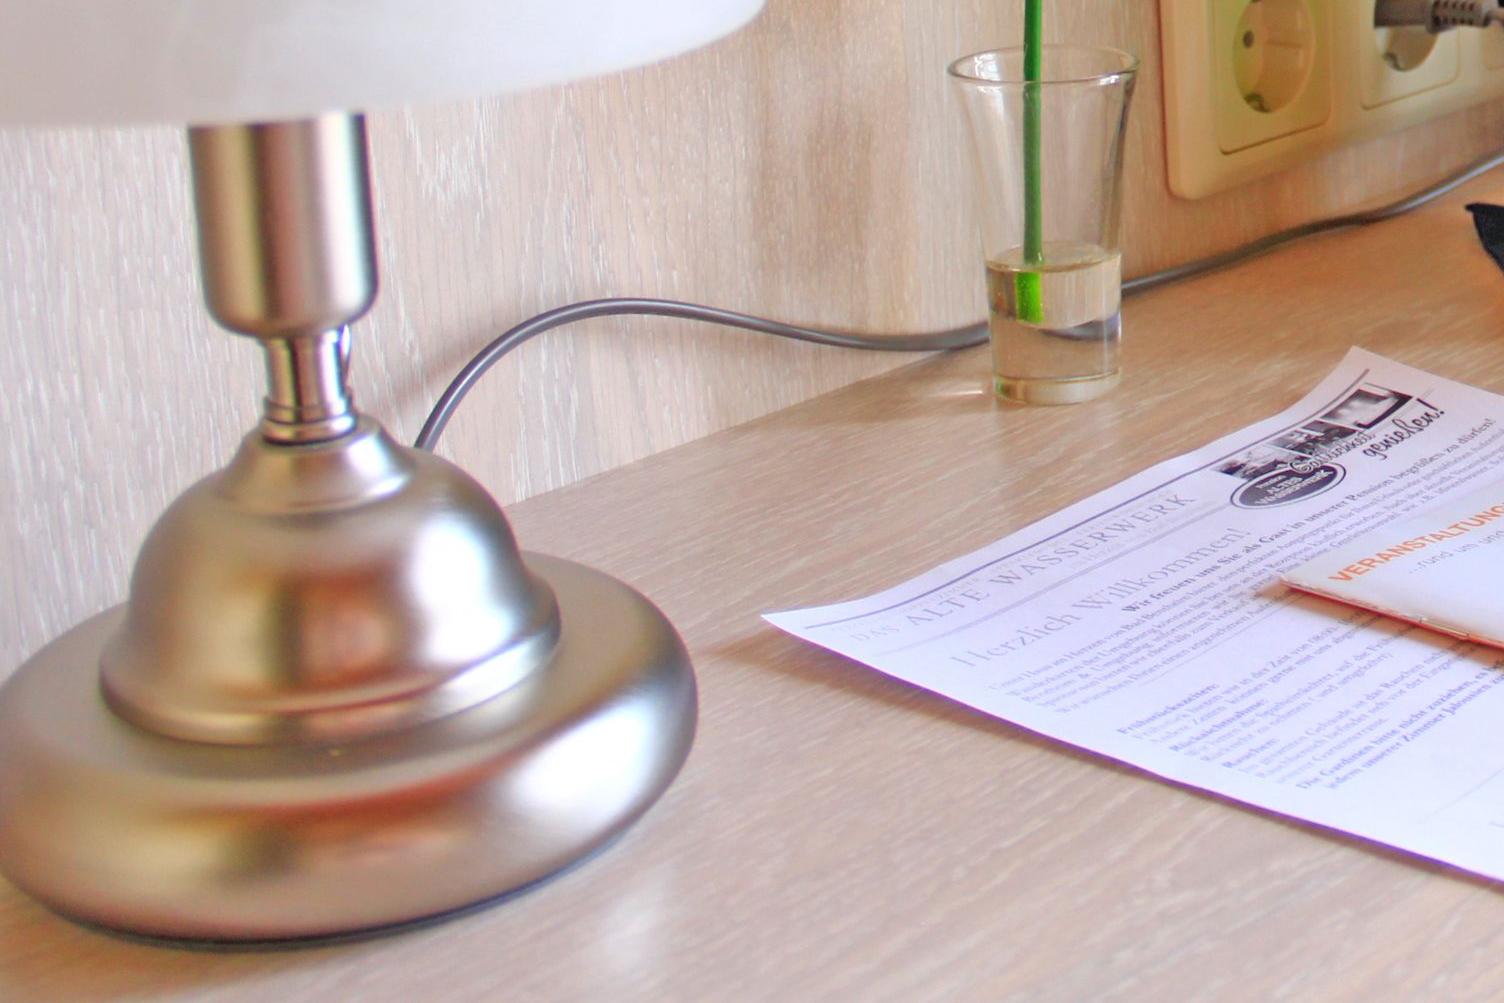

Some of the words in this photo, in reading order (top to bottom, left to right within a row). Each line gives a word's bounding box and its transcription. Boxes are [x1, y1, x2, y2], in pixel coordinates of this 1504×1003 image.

[1362, 396, 1445, 460] genießen!
[902, 585, 992, 626] ALTE
[986, 493, 1197, 587] WASSERWERK
[950, 610, 1083, 668] Herzlich
[1070, 526, 1252, 611] Willkommen!
[1120, 598, 1153, 612] Wir
[1147, 577, 1197, 599] freuen
[1194, 565, 1221, 577] uns
[1215, 553, 1243, 564] Sie
[1239, 543, 1262, 553] als
[1256, 528, 1291, 543] Gast
[1285, 521, 1306, 529] in
[1303, 500, 1349, 522] unserer
[1343, 478, 1395, 501] Pension
[1454, 542, 1480, 554] um
